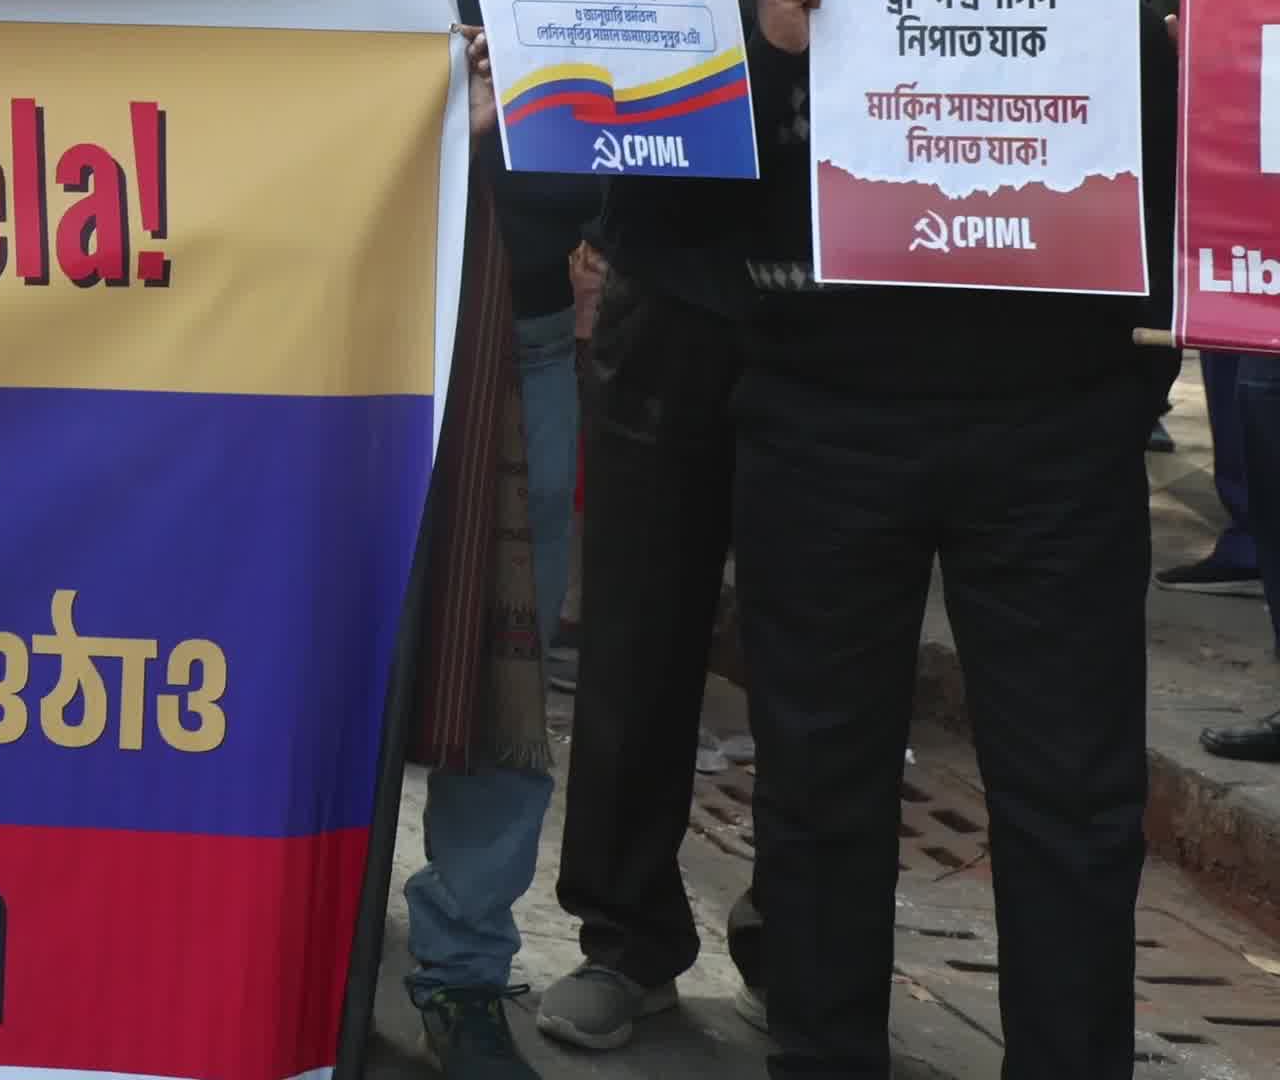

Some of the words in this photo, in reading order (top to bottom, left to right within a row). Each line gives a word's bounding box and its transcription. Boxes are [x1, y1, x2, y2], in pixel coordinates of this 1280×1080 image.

[896, 17, 987, 57] নিপাত
[988, 25, 1047, 57] যাক
[865, 82, 943, 122] মার্কিন
[946, 94, 1090, 124] সাম্রাজ্যবাদ
[624, 134, 690, 168] CPIML
[905, 128, 985, 164] নিপাত
[985, 136, 1048, 165] যাক!
[952, 216, 1036, 250] CPIML
